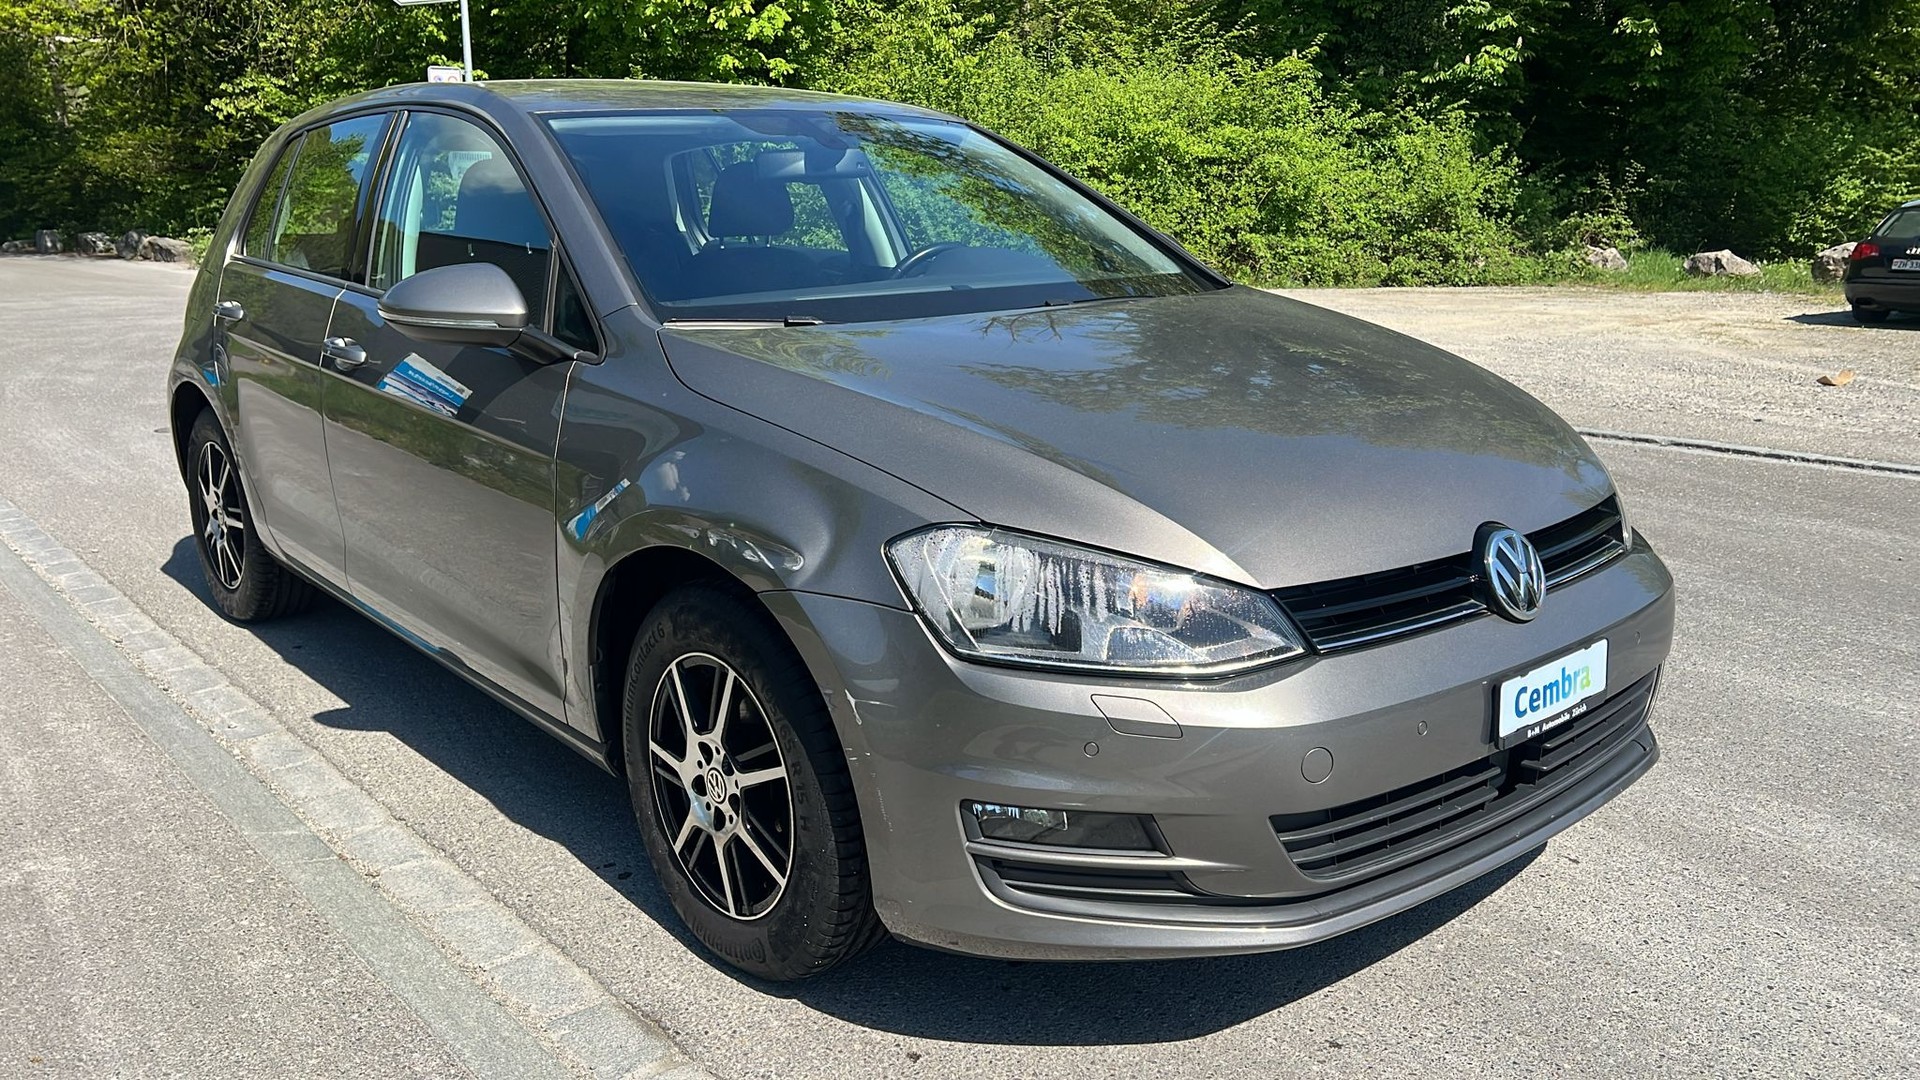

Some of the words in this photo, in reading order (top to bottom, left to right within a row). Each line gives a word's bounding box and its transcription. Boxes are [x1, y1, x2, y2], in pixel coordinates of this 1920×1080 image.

[656, 621, 667, 639] 6
[1514, 665, 1592, 718] Cembra
[1542, 712, 1570, 732] Automobile
[1572, 703, 1587, 717] Zürich
